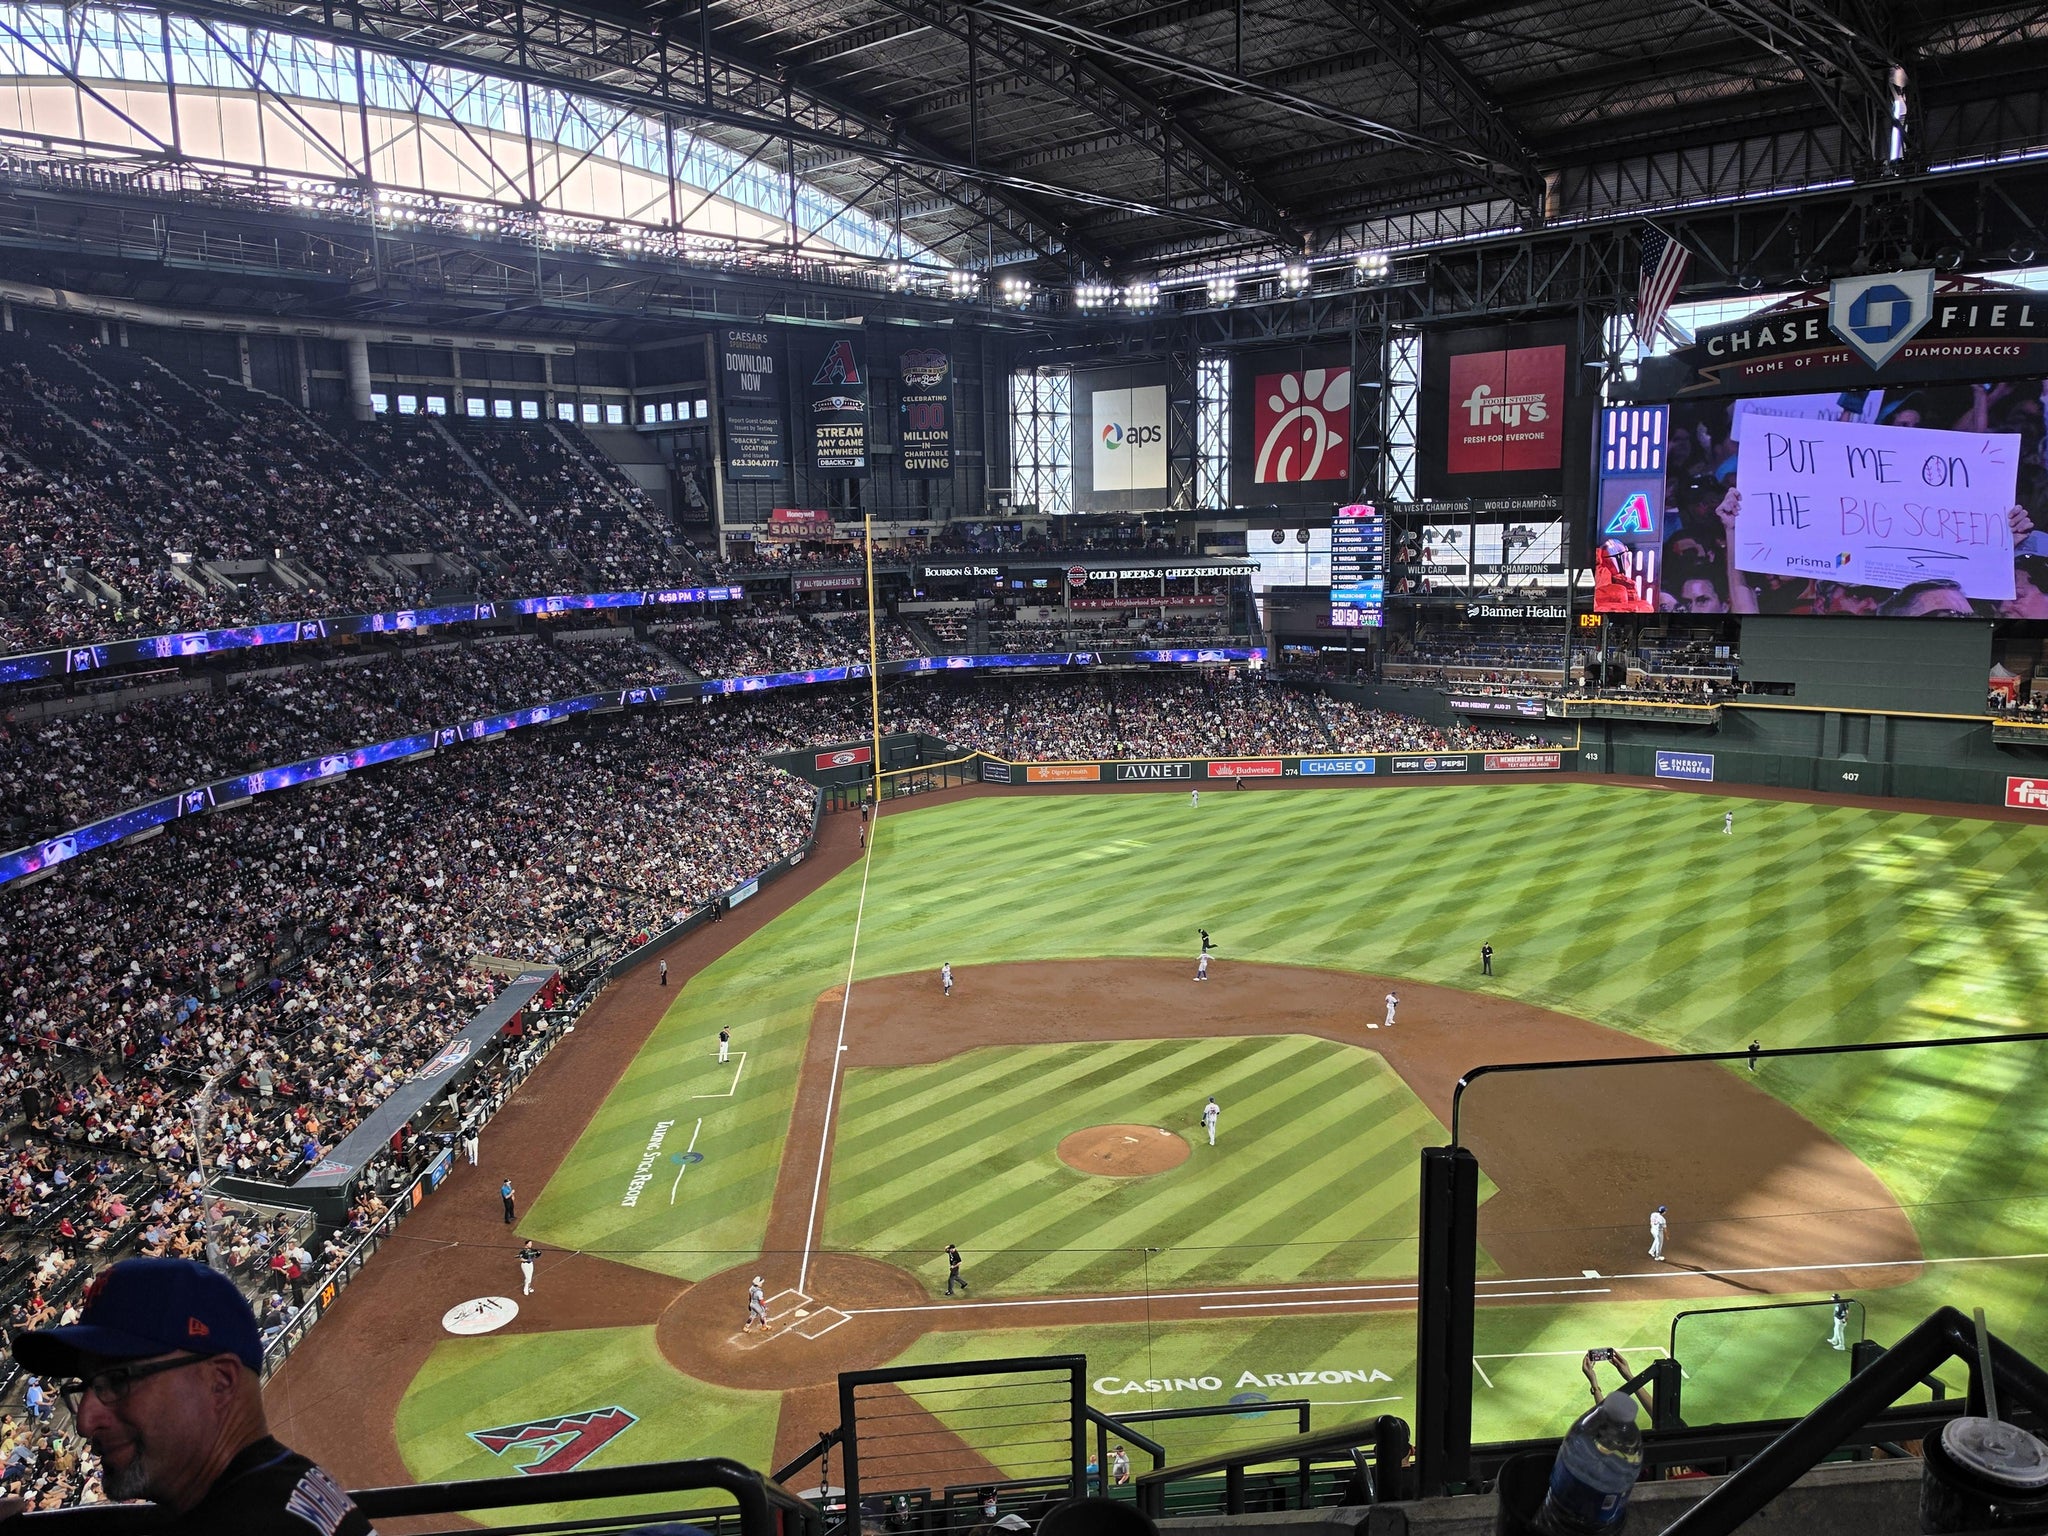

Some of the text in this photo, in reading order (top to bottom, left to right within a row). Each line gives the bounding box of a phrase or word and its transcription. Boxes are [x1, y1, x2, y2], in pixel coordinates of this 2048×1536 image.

[728, 331, 768, 343] CAESARS
[1706, 318, 1819, 357] CHASE
[726, 352, 773, 374] DOWNLOAD
[1745, 345, 2022, 375] HOME OF THE DIAMONDBACKS
[741, 373, 761, 391] NOW
[1461, 384, 1548, 428] fry's
[816, 427, 863, 438] STREAM
[903, 431, 949, 441] MILLION
[1126, 425, 1162, 448] aps
[1463, 432, 1545, 444] FRESH FOR EVERYONE
[817, 438, 864, 448] ANY GAME
[817, 448, 865, 456] ANYWHERE
[904, 450, 949, 458] CHARITABLE
[905, 458, 950, 470] GIVING
[1764, 433, 1825, 475] PUT
[1846, 445, 1903, 484] ME
[1393, 502, 1469, 513] NL WEST CHAMPIONS
[1484, 500, 1557, 510] WORLD CHAMPIONS
[1751, 492, 1811, 530] THE
[1840, 496, 1893, 539] BIG
[1786, 554, 1832, 569] prisma
[925, 566, 999, 577] BOURBON & BONES
[1089, 570, 1118, 580] COLD
[1119, 569, 1154, 579] BEERS
[1156, 569, 1164, 579] &
[1165, 566, 1261, 577] CHEESEBURGERS
[1407, 565, 1448, 574] WILD CARD
[1489, 564, 1549, 574] NL CHAMPIONS
[679, 591, 692, 601] PM
[1101, 600, 1114, 608] Your
[1115, 599, 1149, 607] Neighborhood
[1150, 597, 1169, 606] Burger
[1481, 605, 1567, 618] Banner Health
[1581, 614, 1601, 627] 0:34
[1586, 753, 1598, 761] 413
[1309, 762, 1353, 772] CHASE
[1396, 761, 1419, 769] PEPSI
[1441, 760, 1464, 768] PEPSI
[1671, 759, 1703, 768] ENERGY
[1124, 764, 1183, 778] AVNET
[1236, 766, 1276, 775] Budweiser
[1285, 768, 1298, 776] 374
[1671, 765, 1711, 775] TRANSFER
[1842, 772, 1860, 782] 407
[646, 1119, 675, 1151] TALKING
[636, 1151, 661, 1174] STICK
[621, 1173, 653, 1208] RESORT
[1093, 1369, 1394, 1396] CASINO ARIZONA
[285, 1466, 358, 1536] WRIG
